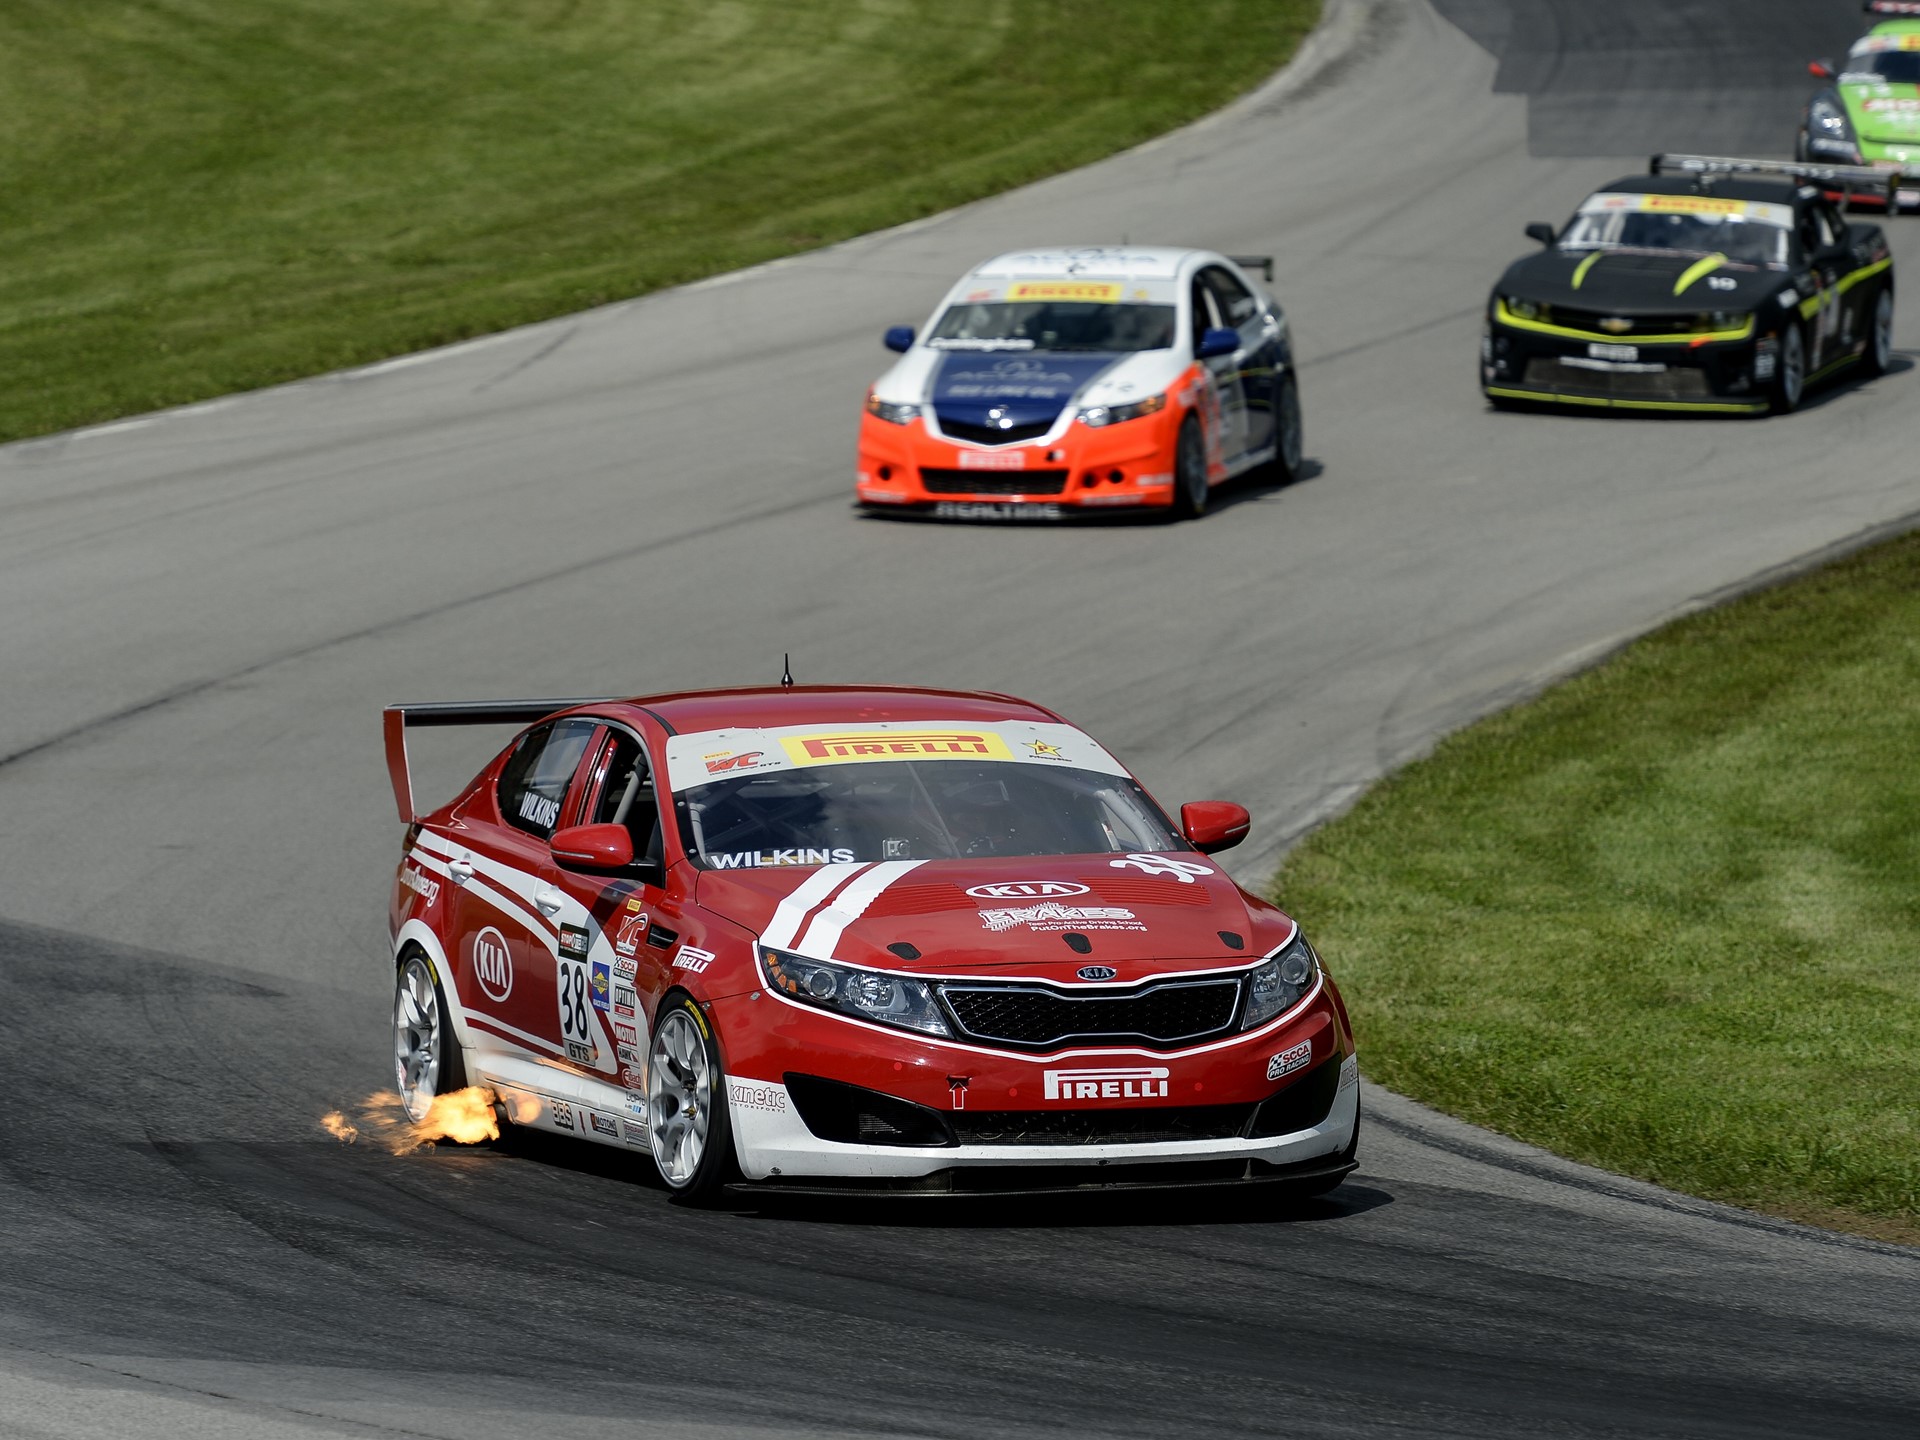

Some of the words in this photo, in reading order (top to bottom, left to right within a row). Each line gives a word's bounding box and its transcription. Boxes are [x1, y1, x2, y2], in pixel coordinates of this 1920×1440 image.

[802, 735, 990, 759] PIRELLI
[519, 791, 560, 829] WILKINS
[711, 848, 855, 870] WILKINS
[982, 883, 1073, 897] KIA
[978, 905, 1137, 927] BRAKES
[479, 940, 507, 989] KIA
[620, 959, 635, 972] SCCA
[671, 944, 716, 974] PIRELLI
[1082, 967, 1112, 979] KIA
[560, 962, 588, 1041] 38
[615, 988, 635, 1007] OPTIMA
[615, 1024, 637, 1044] MOTUL
[569, 1042, 590, 1062] GTS
[1283, 1045, 1310, 1064] SCCA
[1269, 1066, 1285, 1078] PRO
[1285, 1053, 1310, 1071] RACING
[1044, 1067, 1170, 1100] PIRELLI
[551, 1100, 574, 1130] BBS
[730, 1101, 786, 1114] MOTORSPORTS
